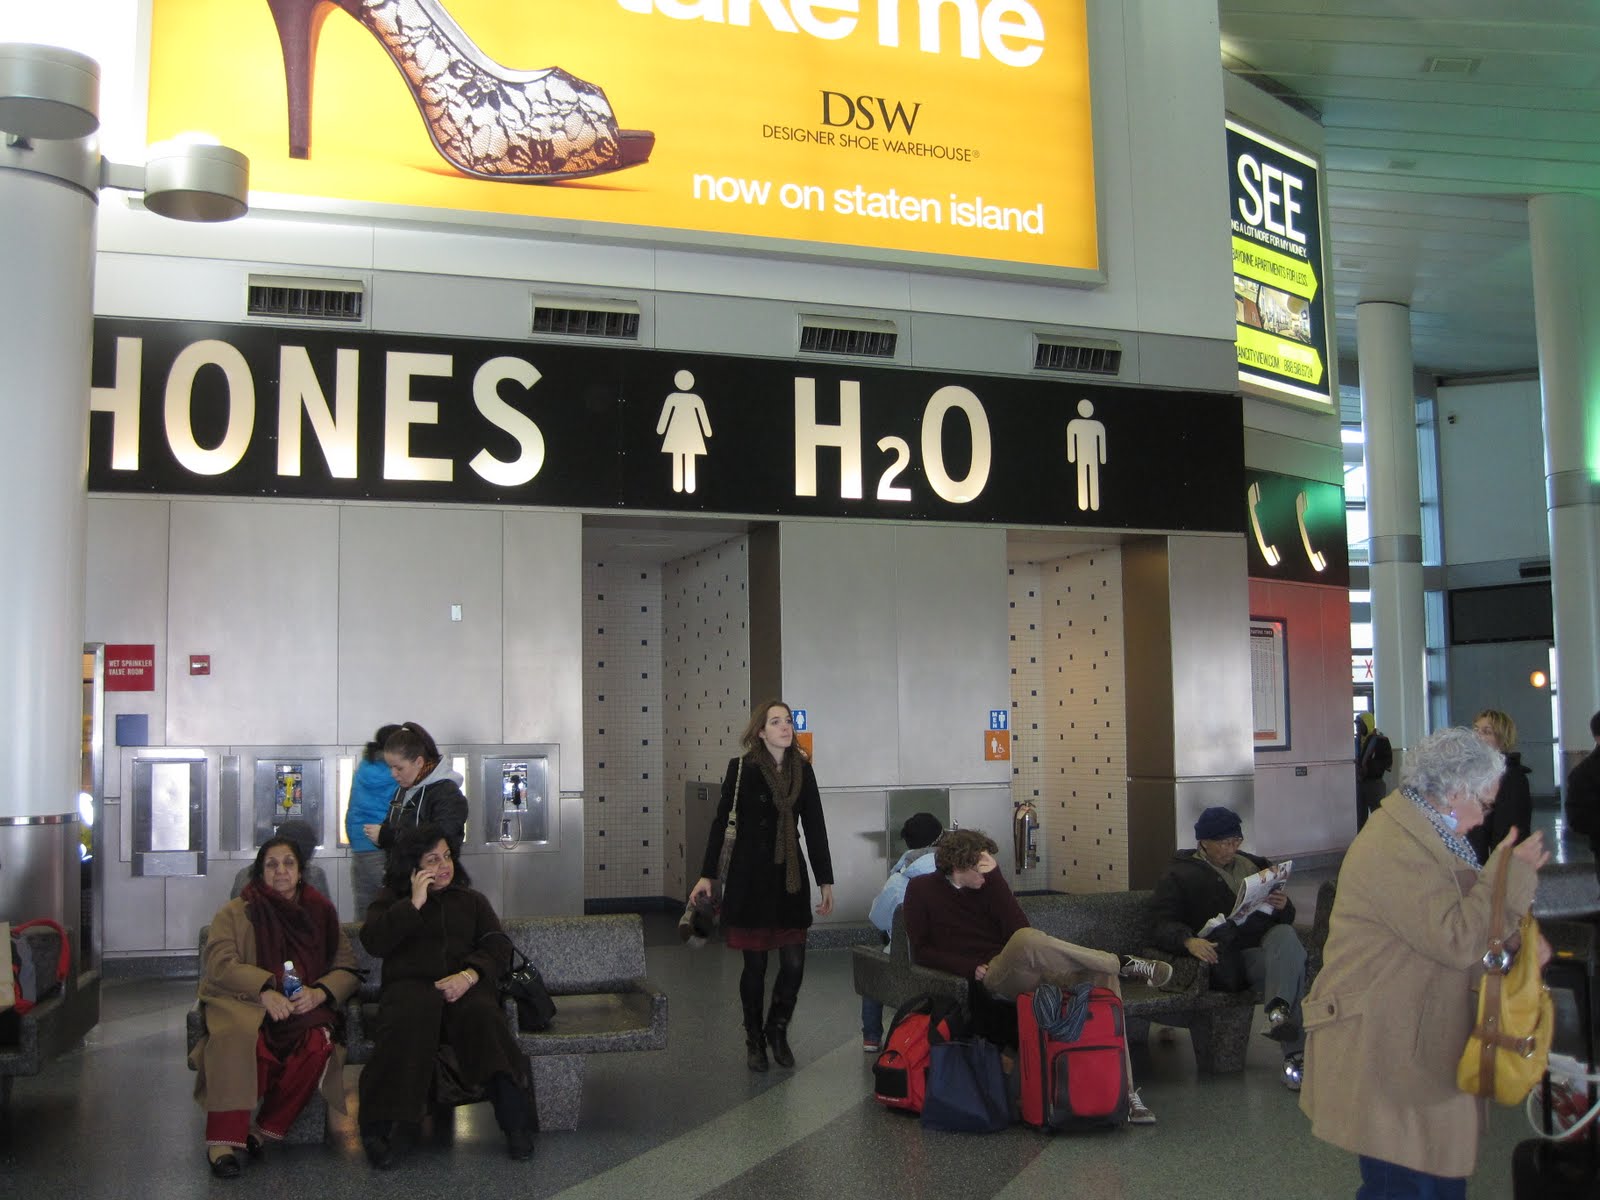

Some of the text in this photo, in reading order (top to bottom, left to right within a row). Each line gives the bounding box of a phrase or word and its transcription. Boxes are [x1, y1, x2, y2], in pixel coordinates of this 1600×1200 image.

[878, 0, 1046, 67] me
[762, 124, 836, 148] DESIGNER
[839, 133, 879, 151] SHOE
[819, 90, 922, 136] DSW
[693, 173, 1044, 235] now on staten island
[1237, 153, 1306, 245] SEE
[1244, 224, 1255, 238] LOT
[1254, 228, 1270, 244] MORE
[1270, 234, 1281, 247] FOR
[1255, 255, 1287, 279] APARTMENTS
[1286, 267, 1296, 281] FOR
[90, 336, 546, 488] HONES
[794, 376, 993, 504] H2O
